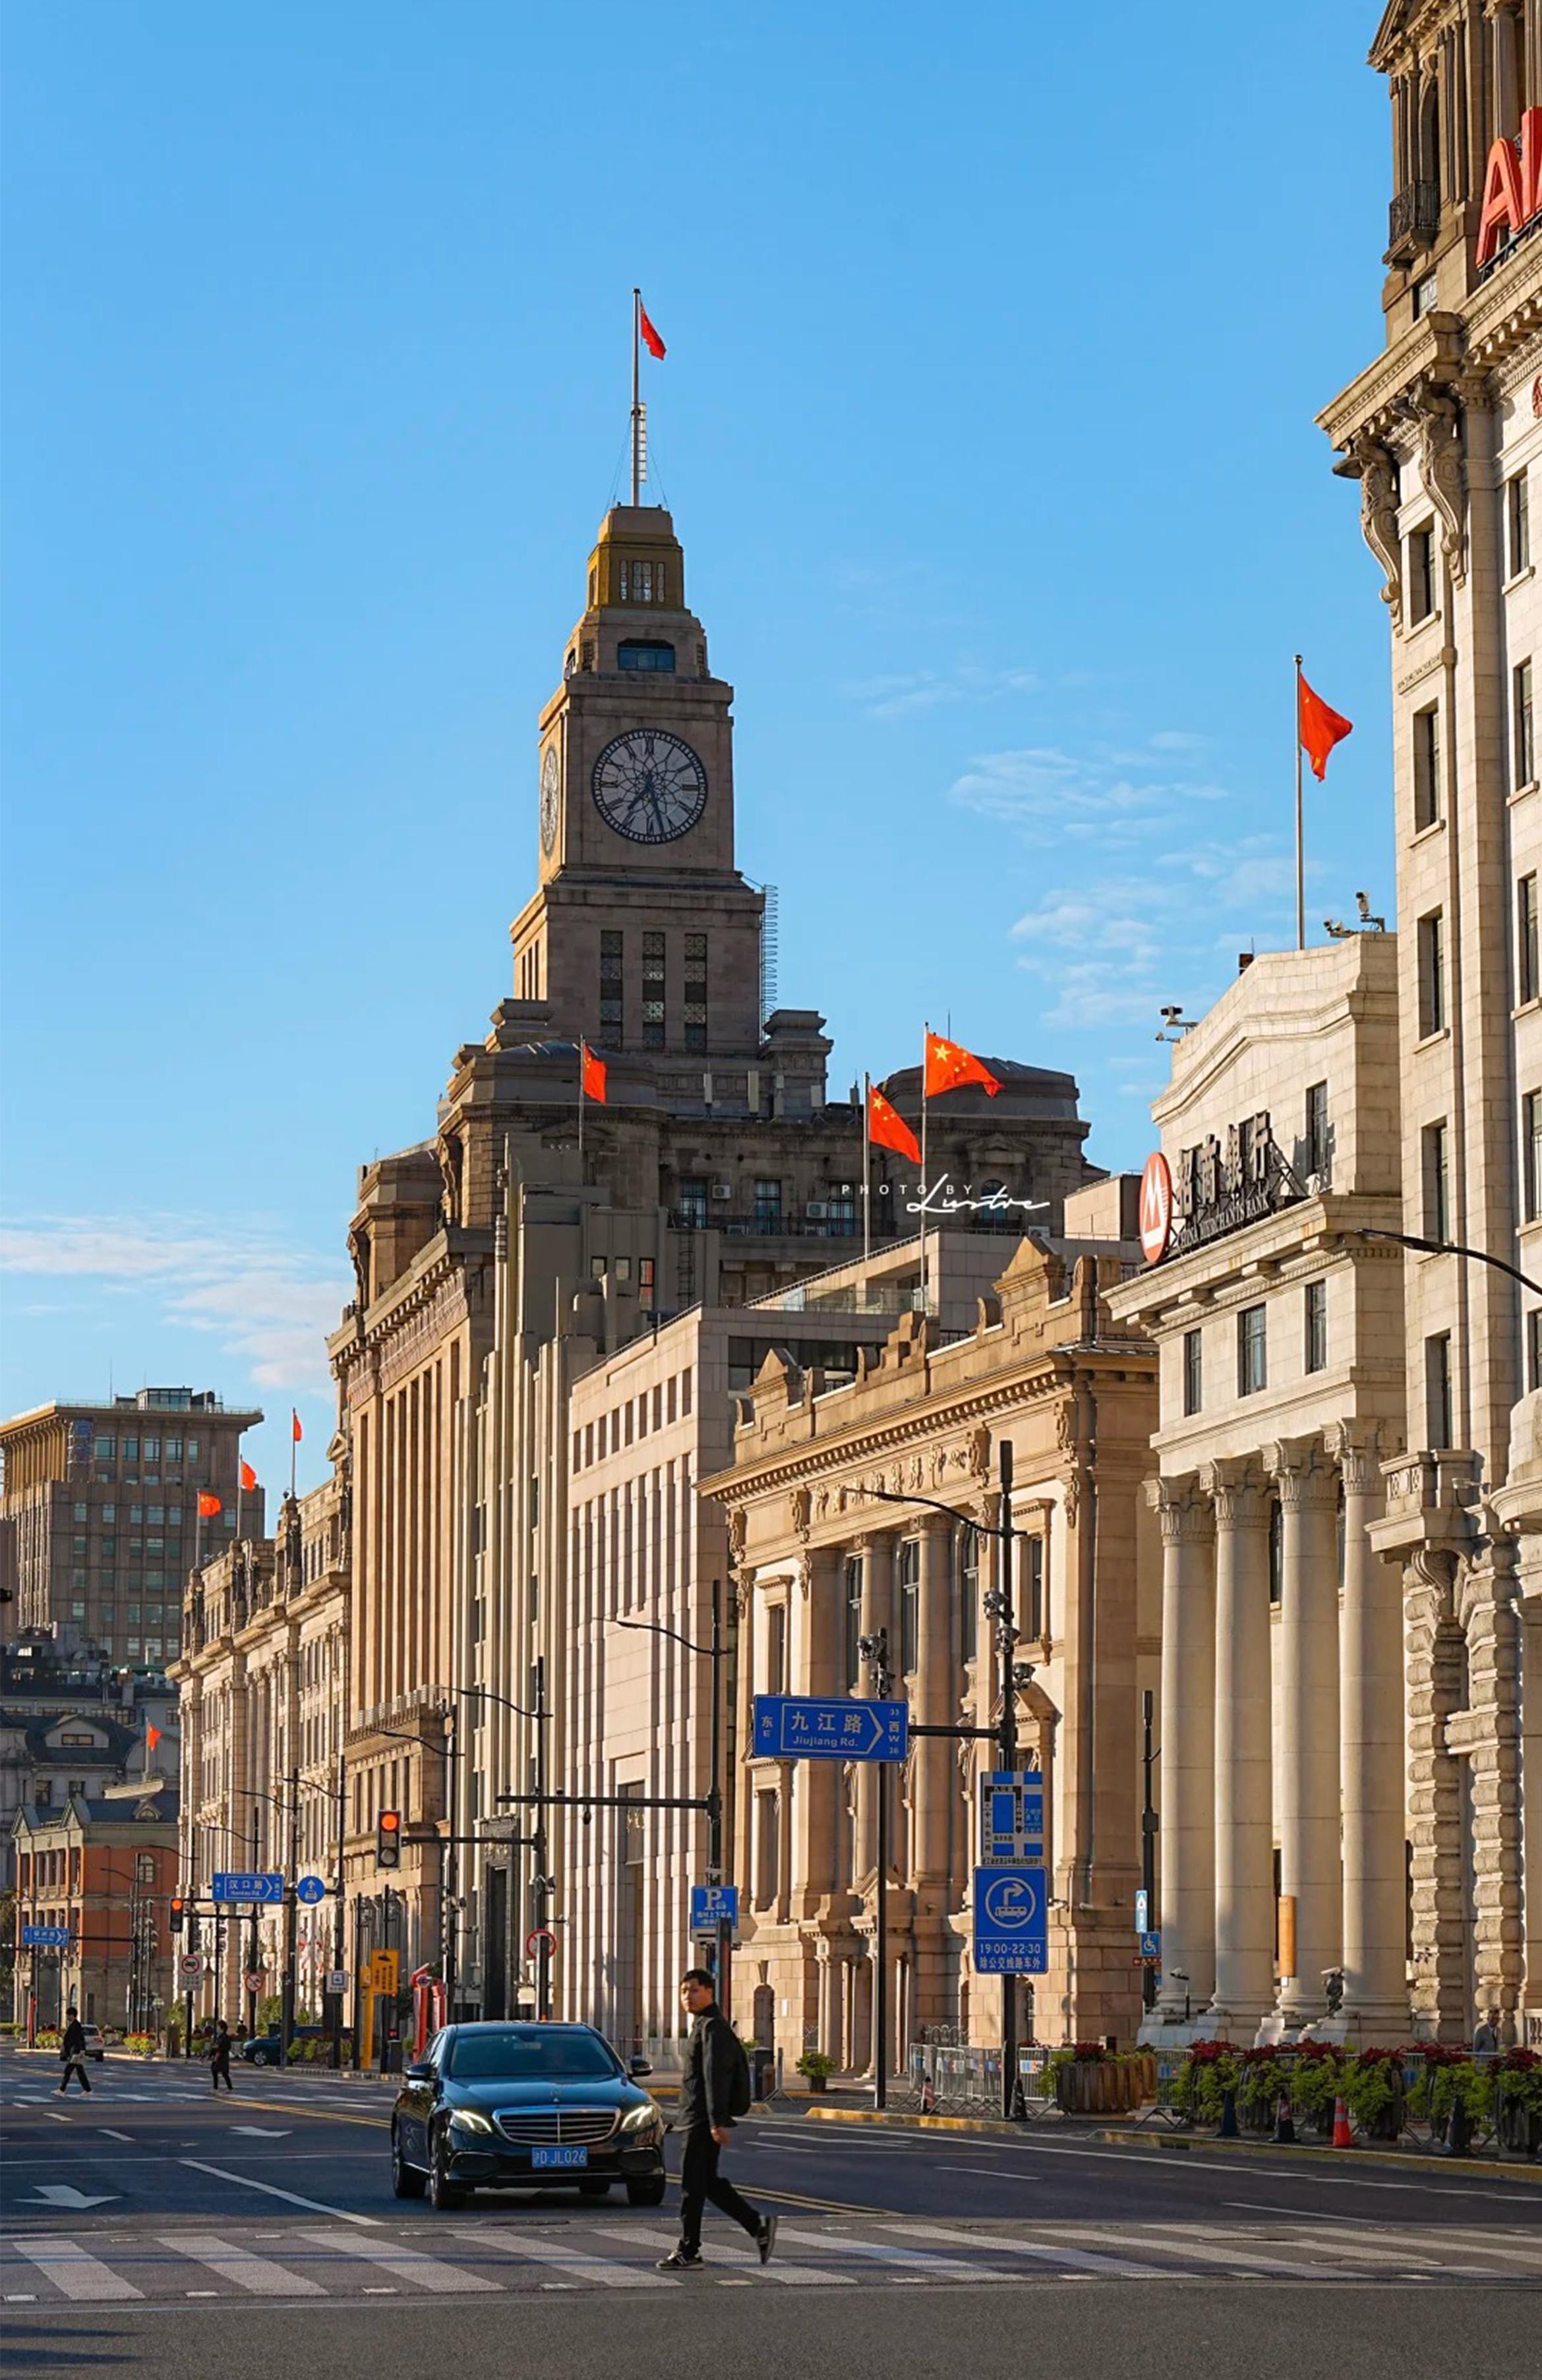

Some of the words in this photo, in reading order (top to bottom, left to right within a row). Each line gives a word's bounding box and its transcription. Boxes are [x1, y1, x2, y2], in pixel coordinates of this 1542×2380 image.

[1475, 105, 1542, 268] AI
[1176, 1110, 1272, 1217] 招商银行
[761, 1716, 773, 1727] 东
[790, 1712, 863, 1733] 九江路
[888, 1721, 901, 1733] 西
[793, 1736, 838, 1747] Jiujiang
[841, 1737, 858, 1747] Rd.
[705, 1889, 723, 1910] P
[980, 1943, 1041, 1954] 19:00-22:30
